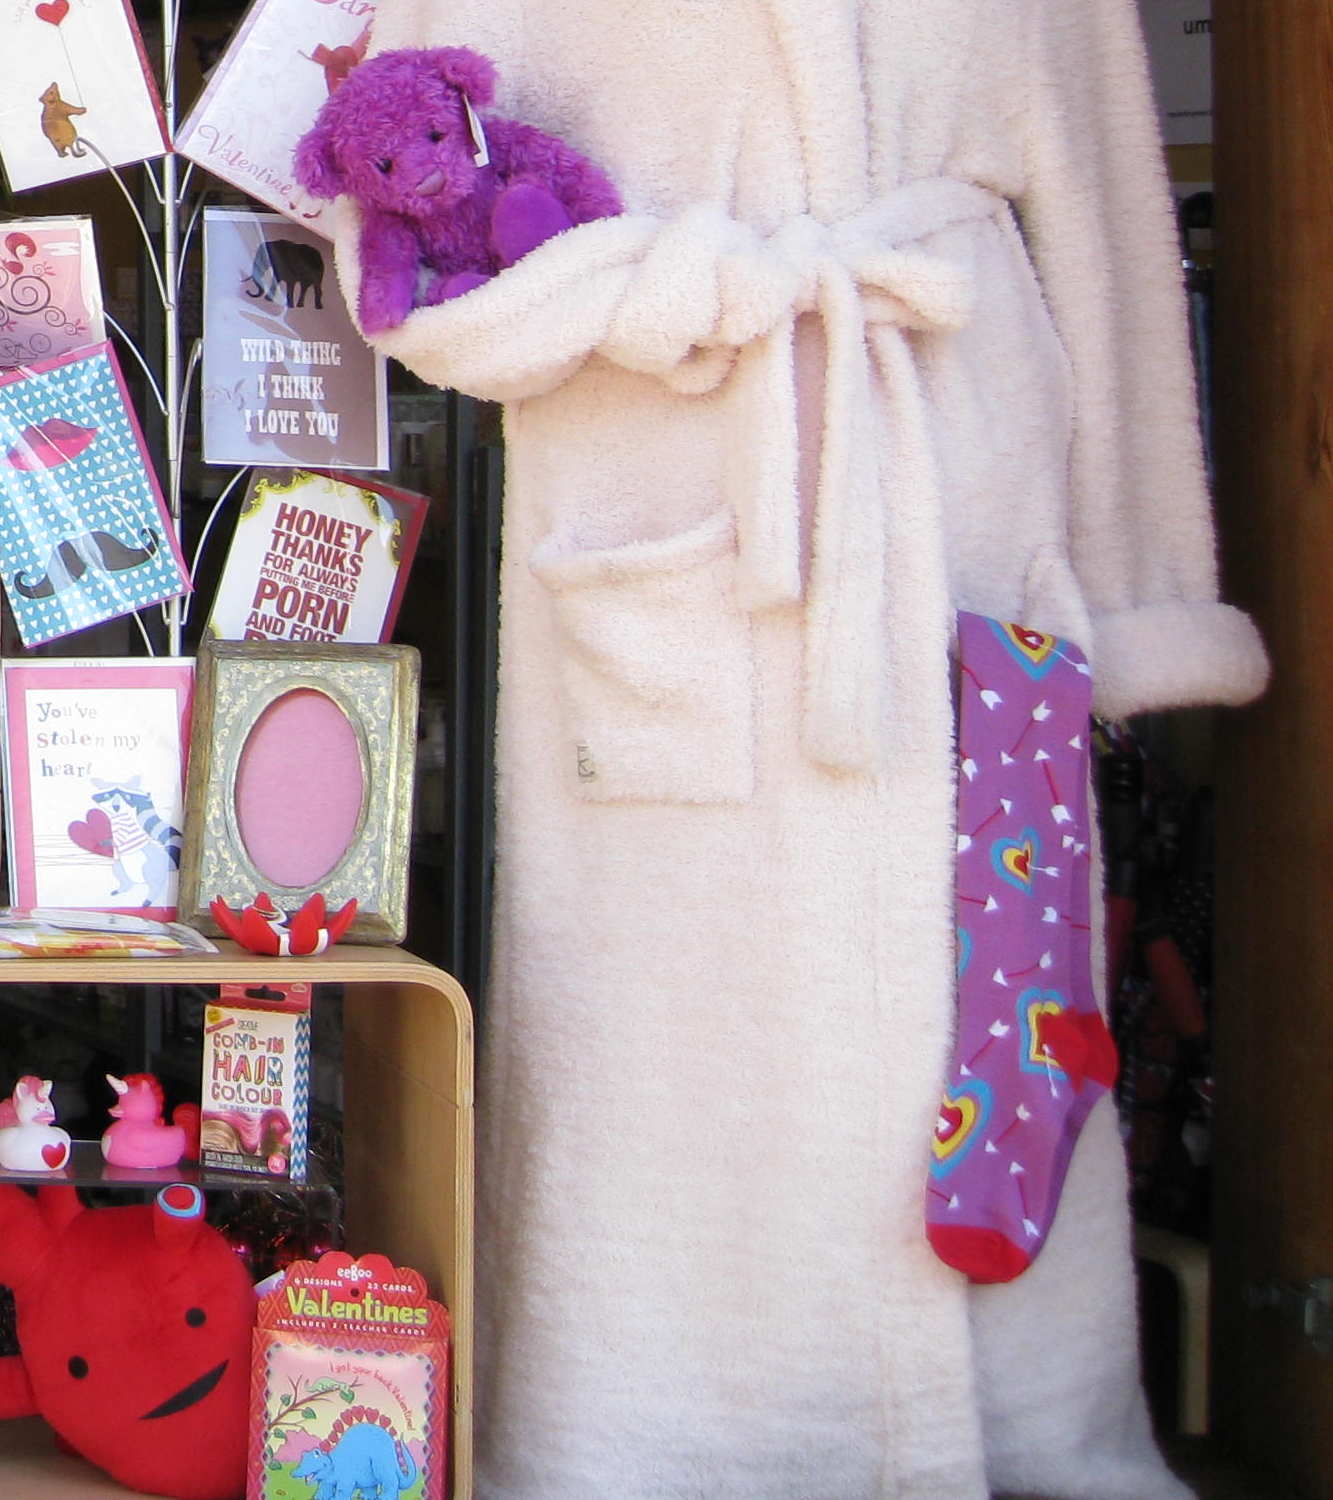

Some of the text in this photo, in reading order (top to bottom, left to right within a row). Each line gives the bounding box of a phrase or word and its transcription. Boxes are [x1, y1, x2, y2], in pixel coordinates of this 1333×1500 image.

[198, 125, 293, 195] Valentine
[241, 338, 342, 366] WILD THING
[257, 374, 325, 400] I THINK
[244, 408, 339, 437] I LOVE YOU
[275, 502, 373, 553] HONEY
[271, 529, 363, 577] THANKS
[260, 566, 355, 603] PUTTING ME BEFORE
[263, 551, 358, 593] FOR ALWAYS
[252, 577, 350, 635] PORN
[245, 611, 286, 636] AND
[113, 734, 141, 750] my
[41, 758, 92, 777] heart
[213, 1032, 284, 1054] COMB-IN
[213, 1049, 284, 1087] HAIR
[211, 1082, 283, 1106] COLOUR
[304, 1278, 343, 1287] DESIGNS
[382, 1283, 413, 1292] CARDS
[337, 1264, 373, 1281] eeBoo
[286, 1286, 429, 1325] Valentines
[277, 1319, 326, 1329] INCLUDES
[343, 1324, 387, 1333] TEACHER
[393, 1327, 426, 1336] CARDS
